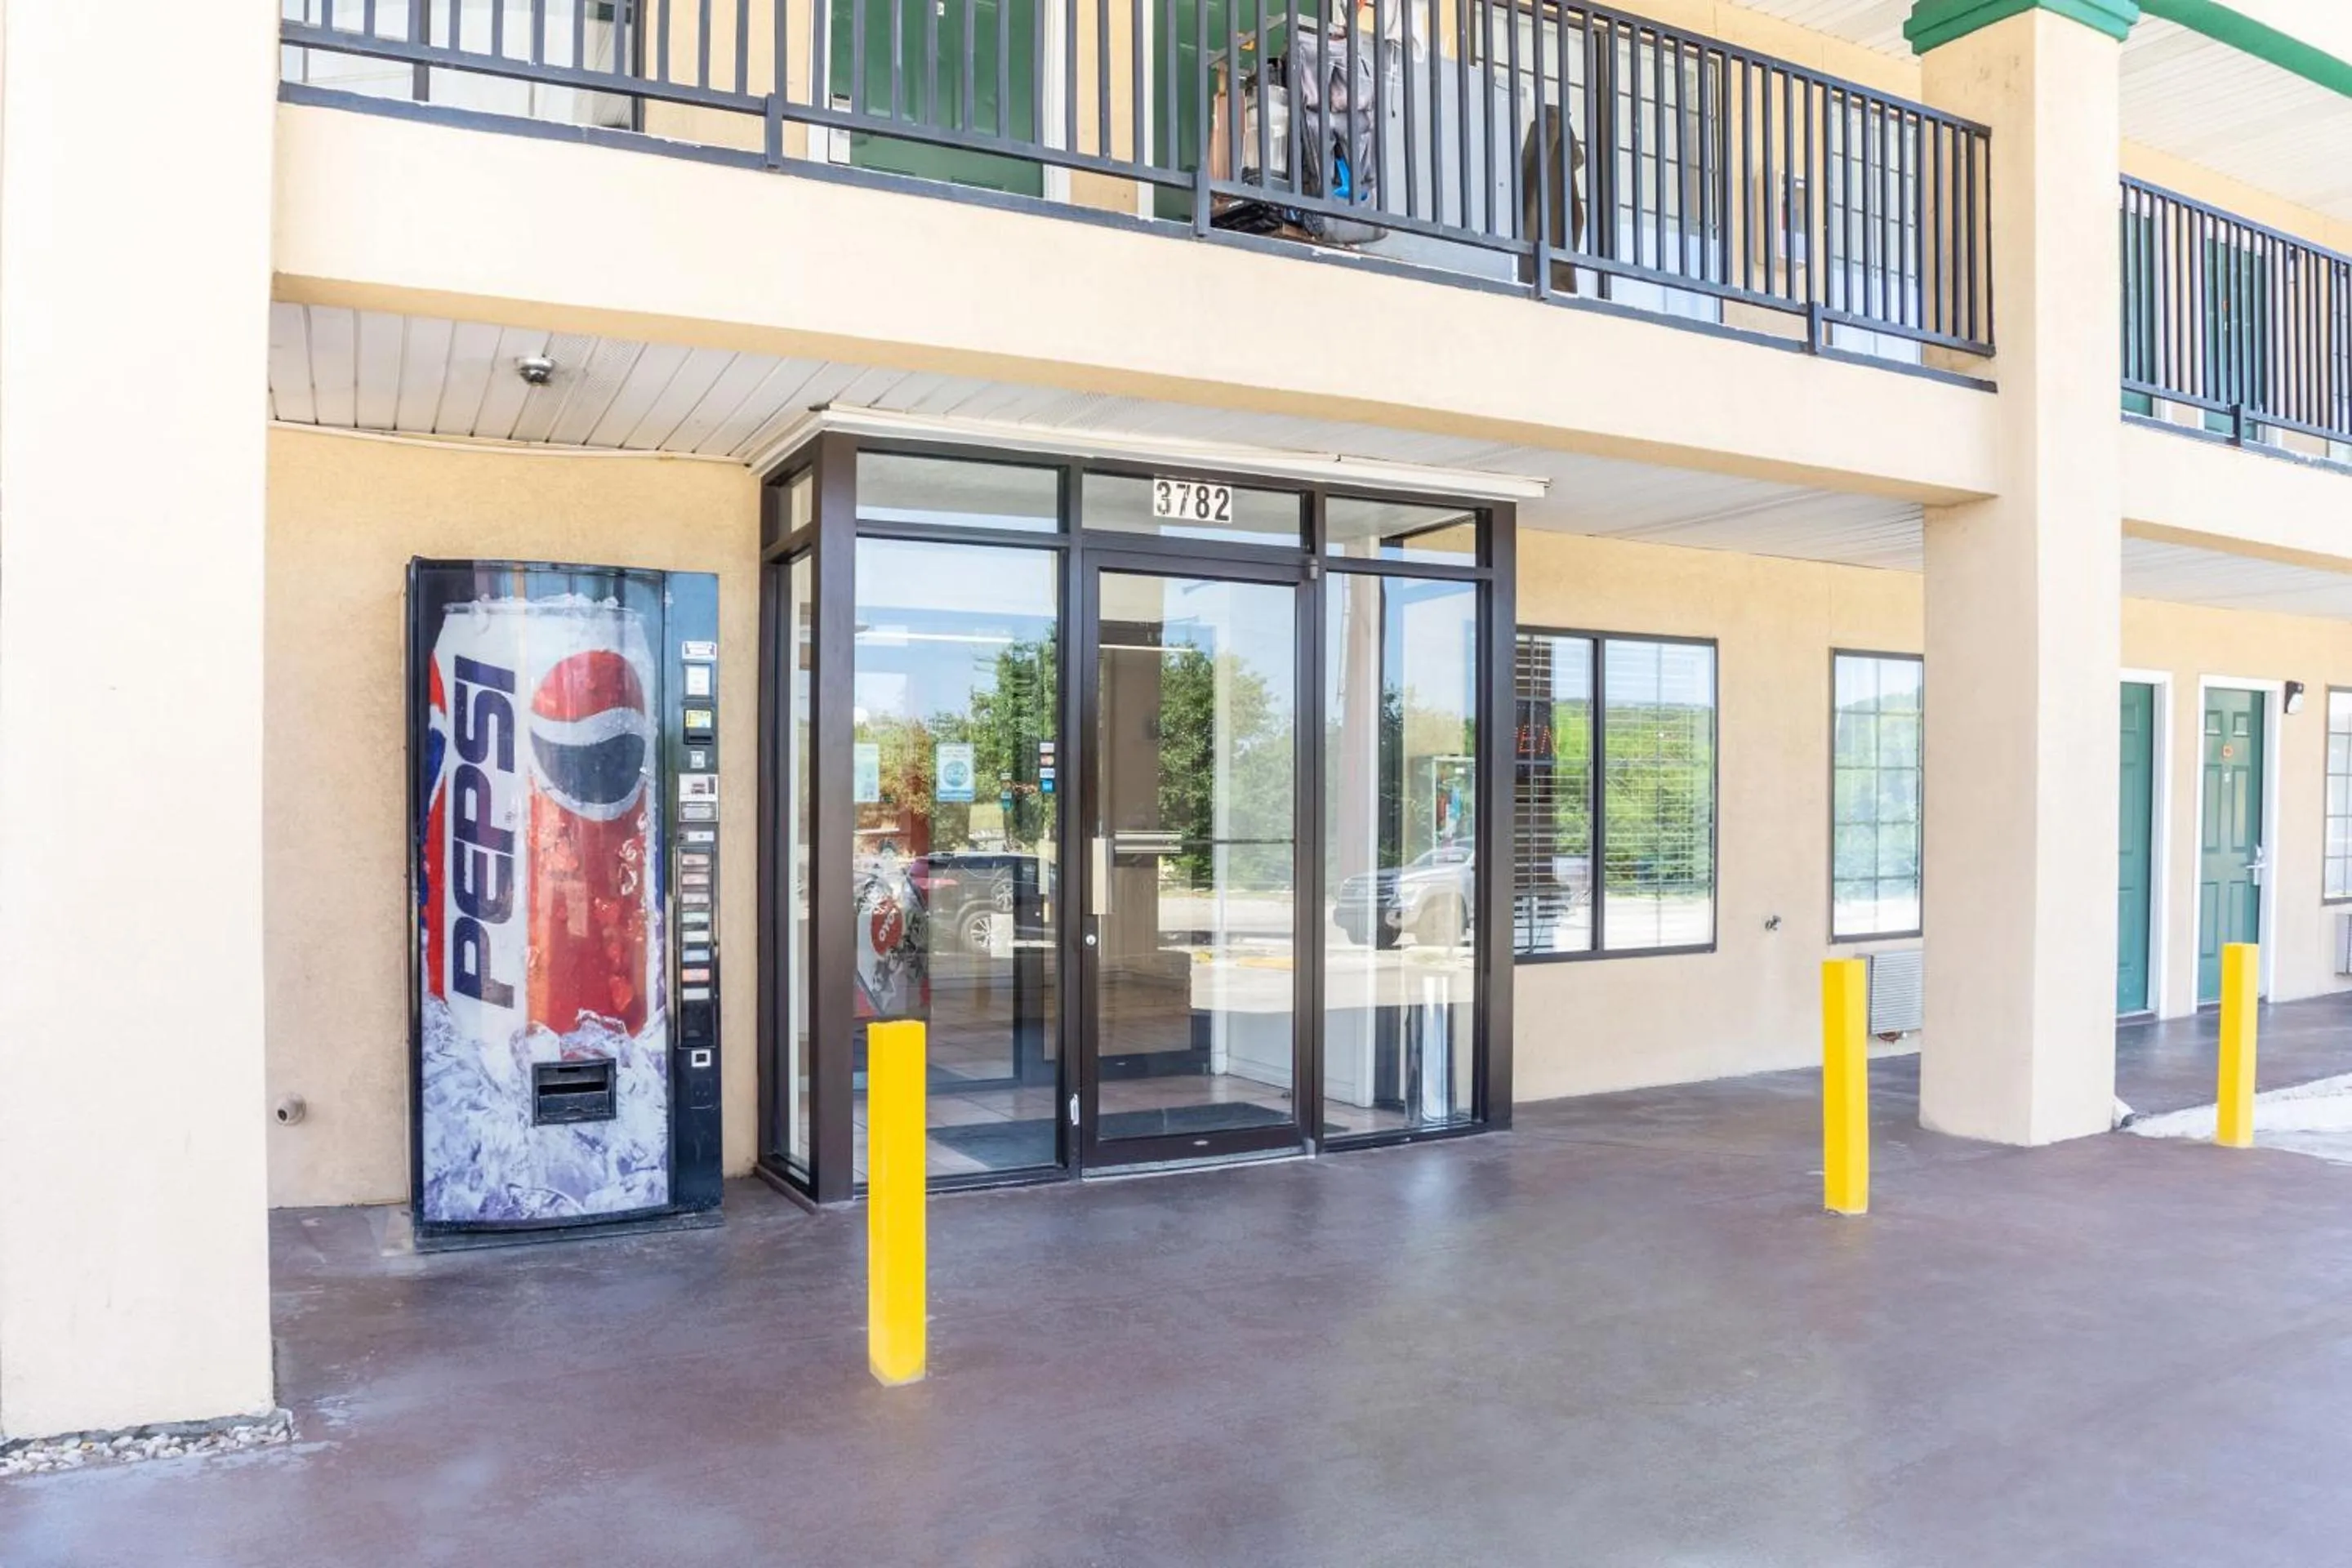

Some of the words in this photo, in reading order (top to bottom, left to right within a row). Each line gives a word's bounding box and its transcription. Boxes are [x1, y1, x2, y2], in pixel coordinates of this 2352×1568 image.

[1156, 481, 1230, 521] 3782
[1516, 725, 1558, 753] EN
[452, 655, 515, 1009] PEPSI
